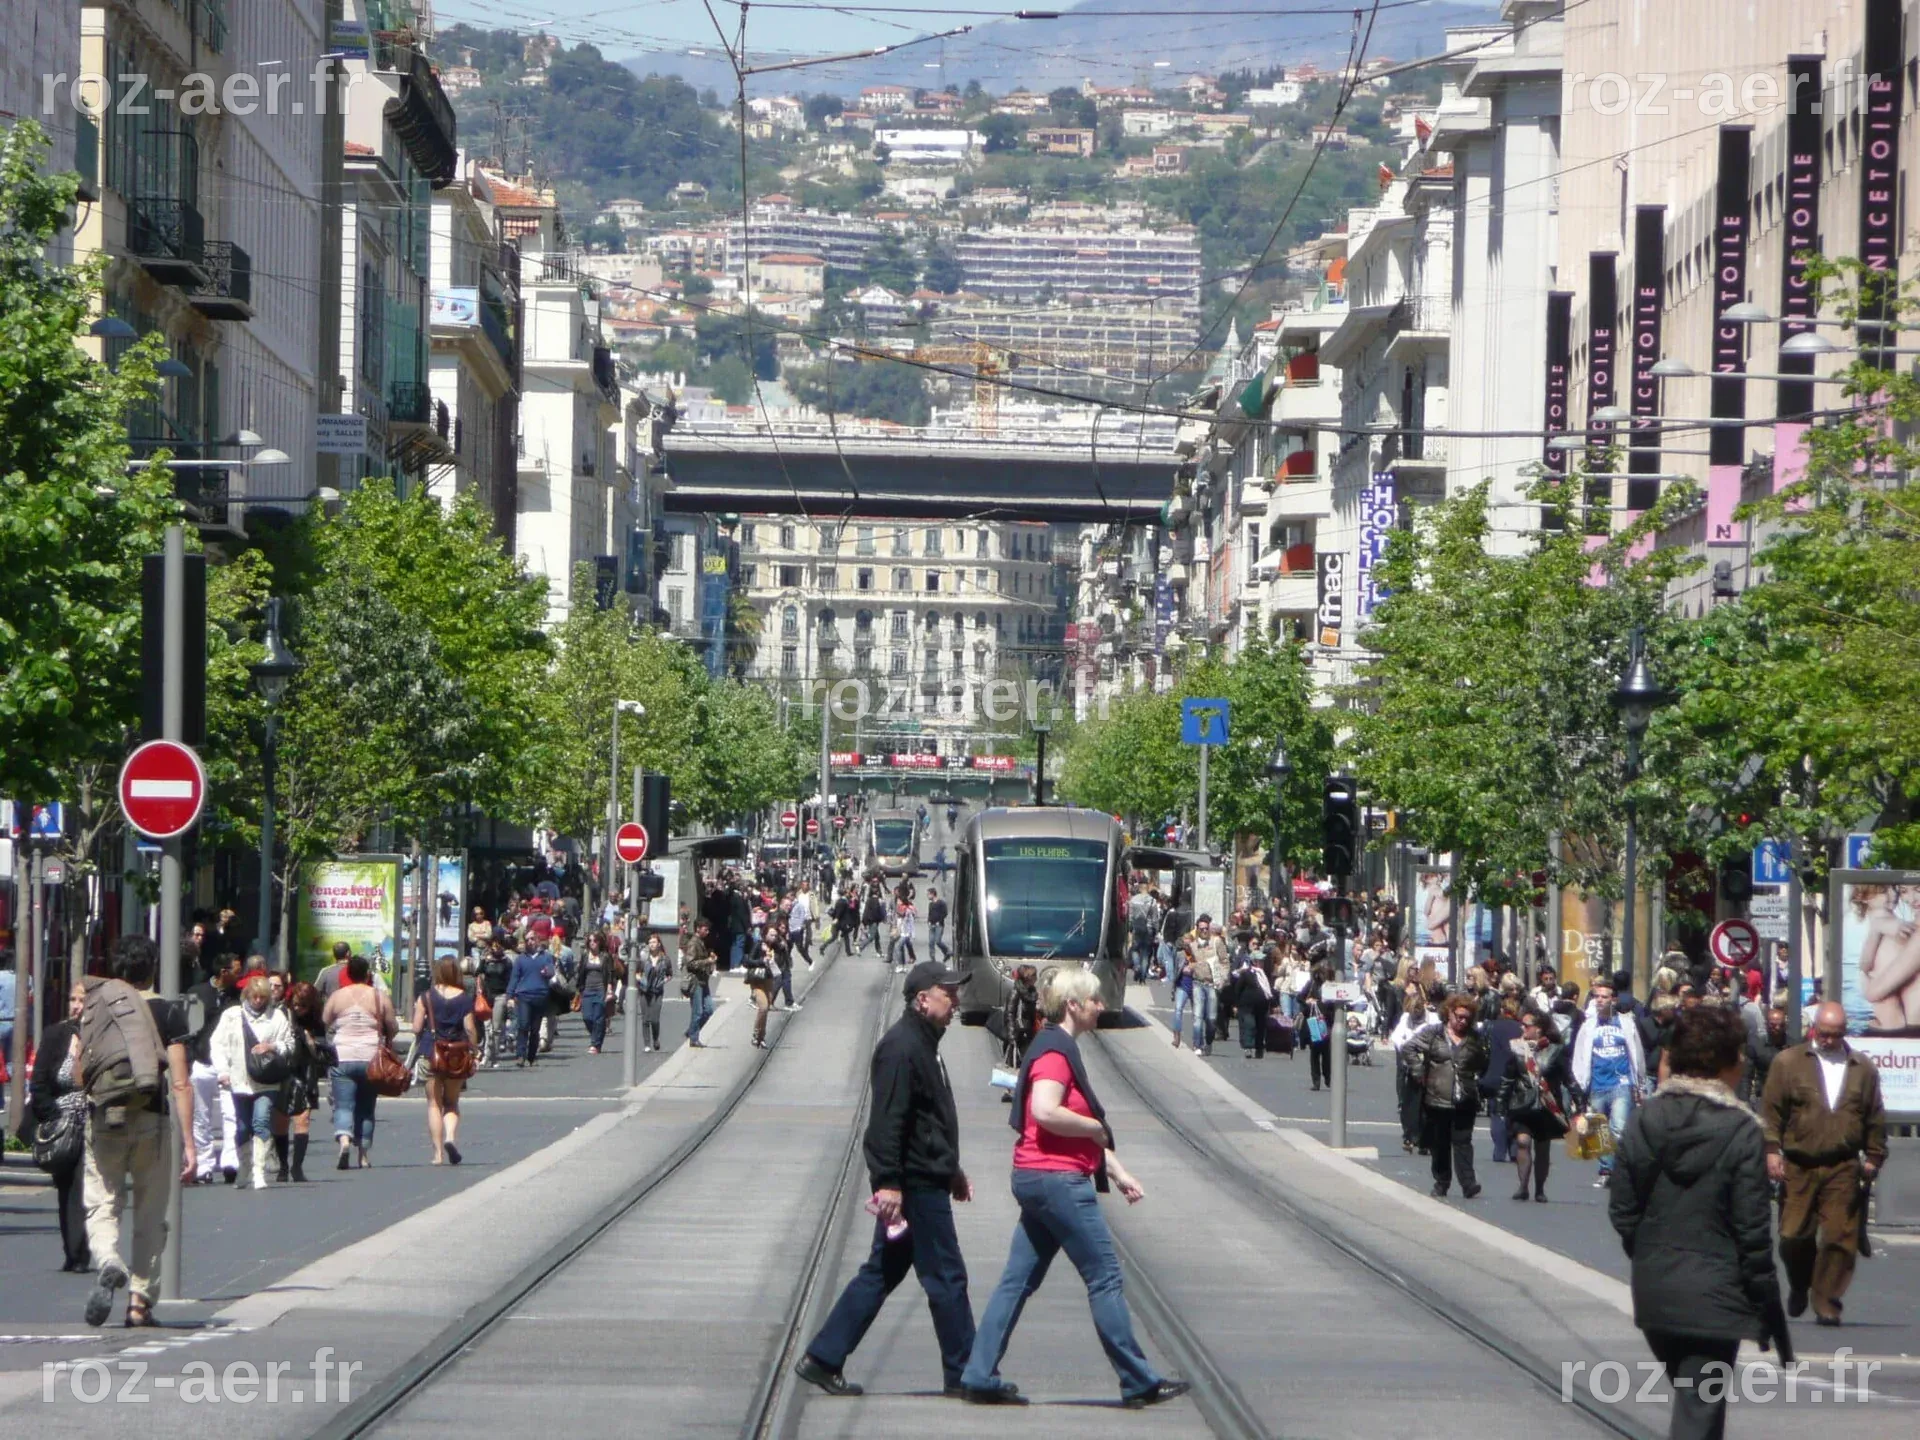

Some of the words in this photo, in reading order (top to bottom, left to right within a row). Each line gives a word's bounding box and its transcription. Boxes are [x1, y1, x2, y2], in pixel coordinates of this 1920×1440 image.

[1719, 216, 1741, 374] NICTOILE
[1319, 555, 1342, 625] fnac
[308, 885, 348, 896] Venez
[310, 900, 327, 909] en
[330, 898, 381, 910] famille
[1861, 1049, 1920, 1070] adum
